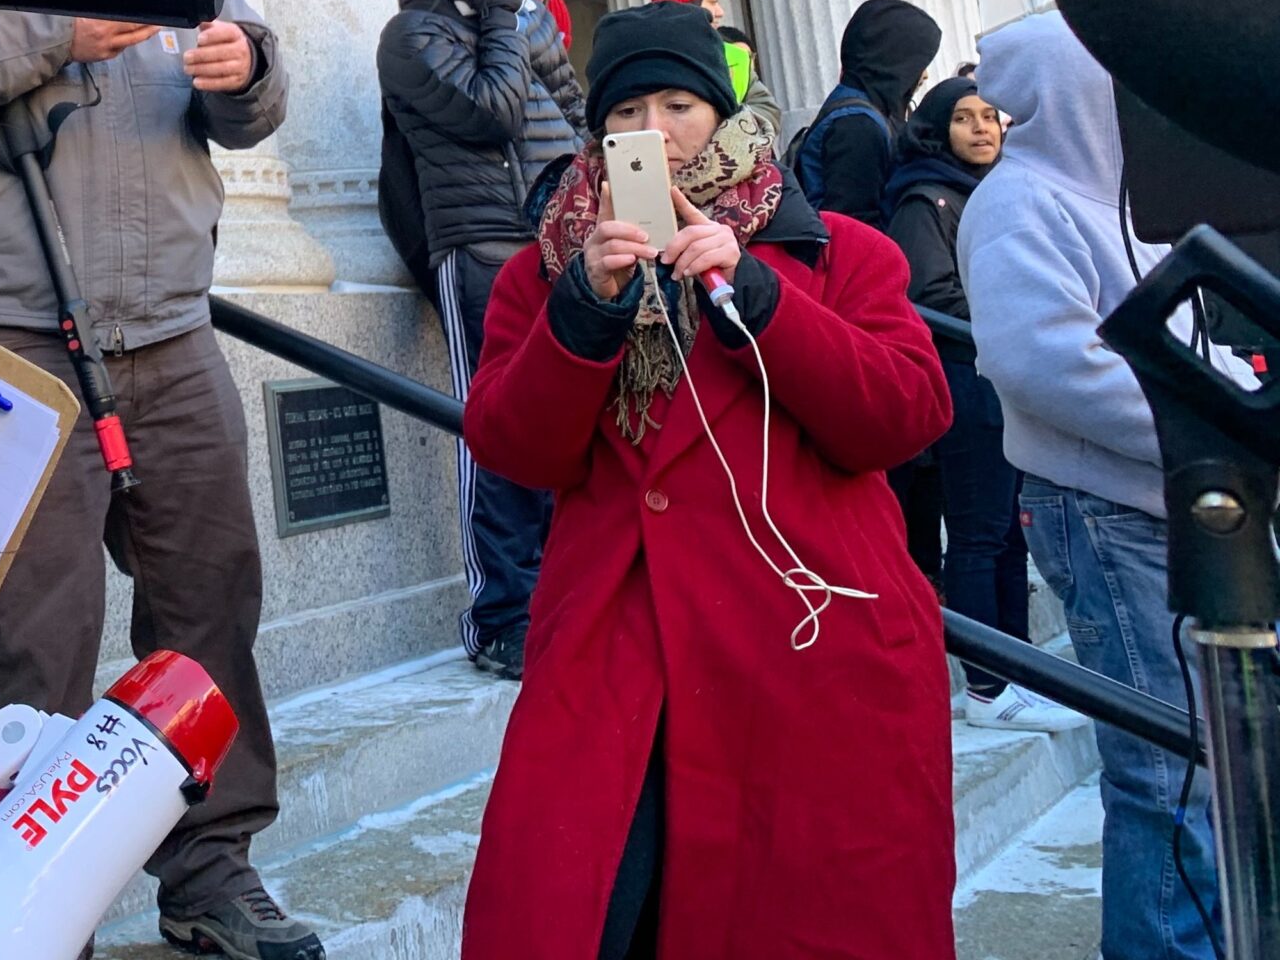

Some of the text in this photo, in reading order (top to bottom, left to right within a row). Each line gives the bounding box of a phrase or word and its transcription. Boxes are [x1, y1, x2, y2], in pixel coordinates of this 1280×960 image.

[0, 750, 73, 822] PyleUSA.com
[96, 737, 158, 794] Voces
[11, 758, 97, 847] PYLE
